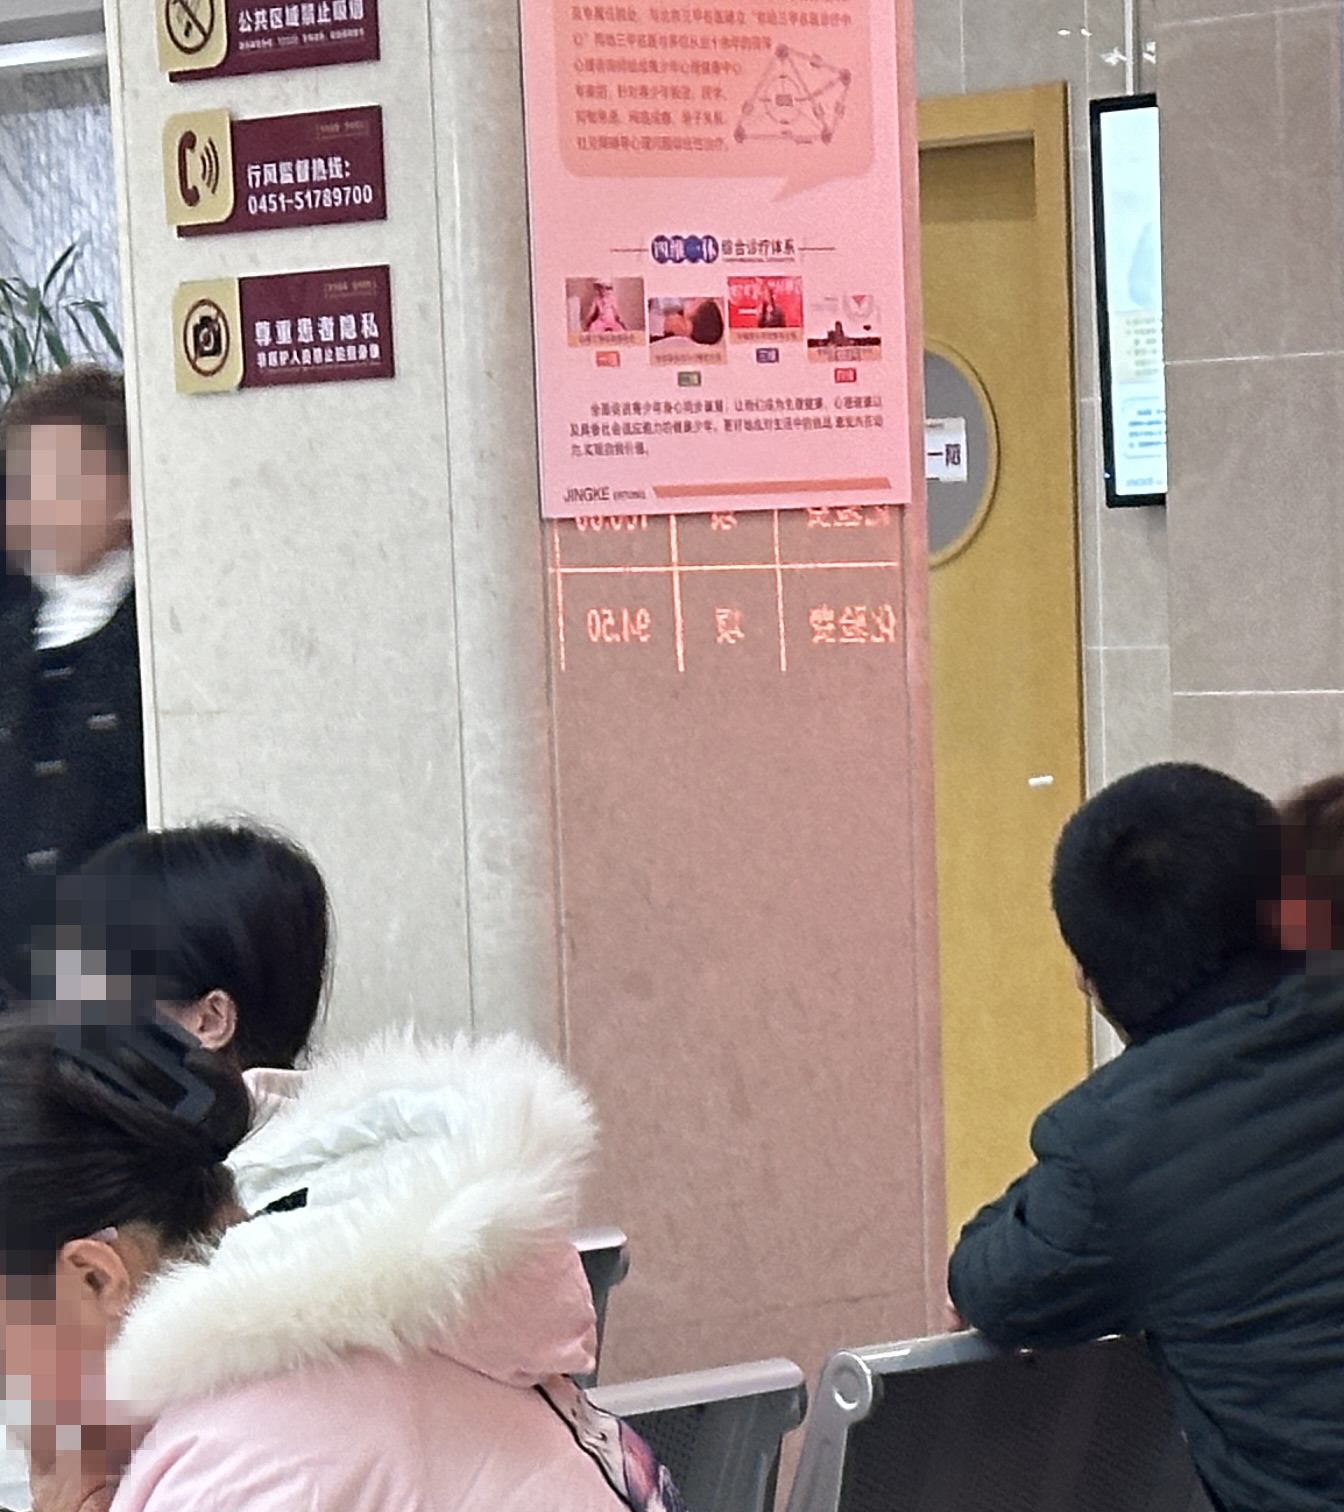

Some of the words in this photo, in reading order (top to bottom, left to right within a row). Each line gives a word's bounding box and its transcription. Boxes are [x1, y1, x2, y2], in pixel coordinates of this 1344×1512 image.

[248, 184, 373, 215] 0451-51789700
[255, 312, 379, 347] 尊重患者隐私
